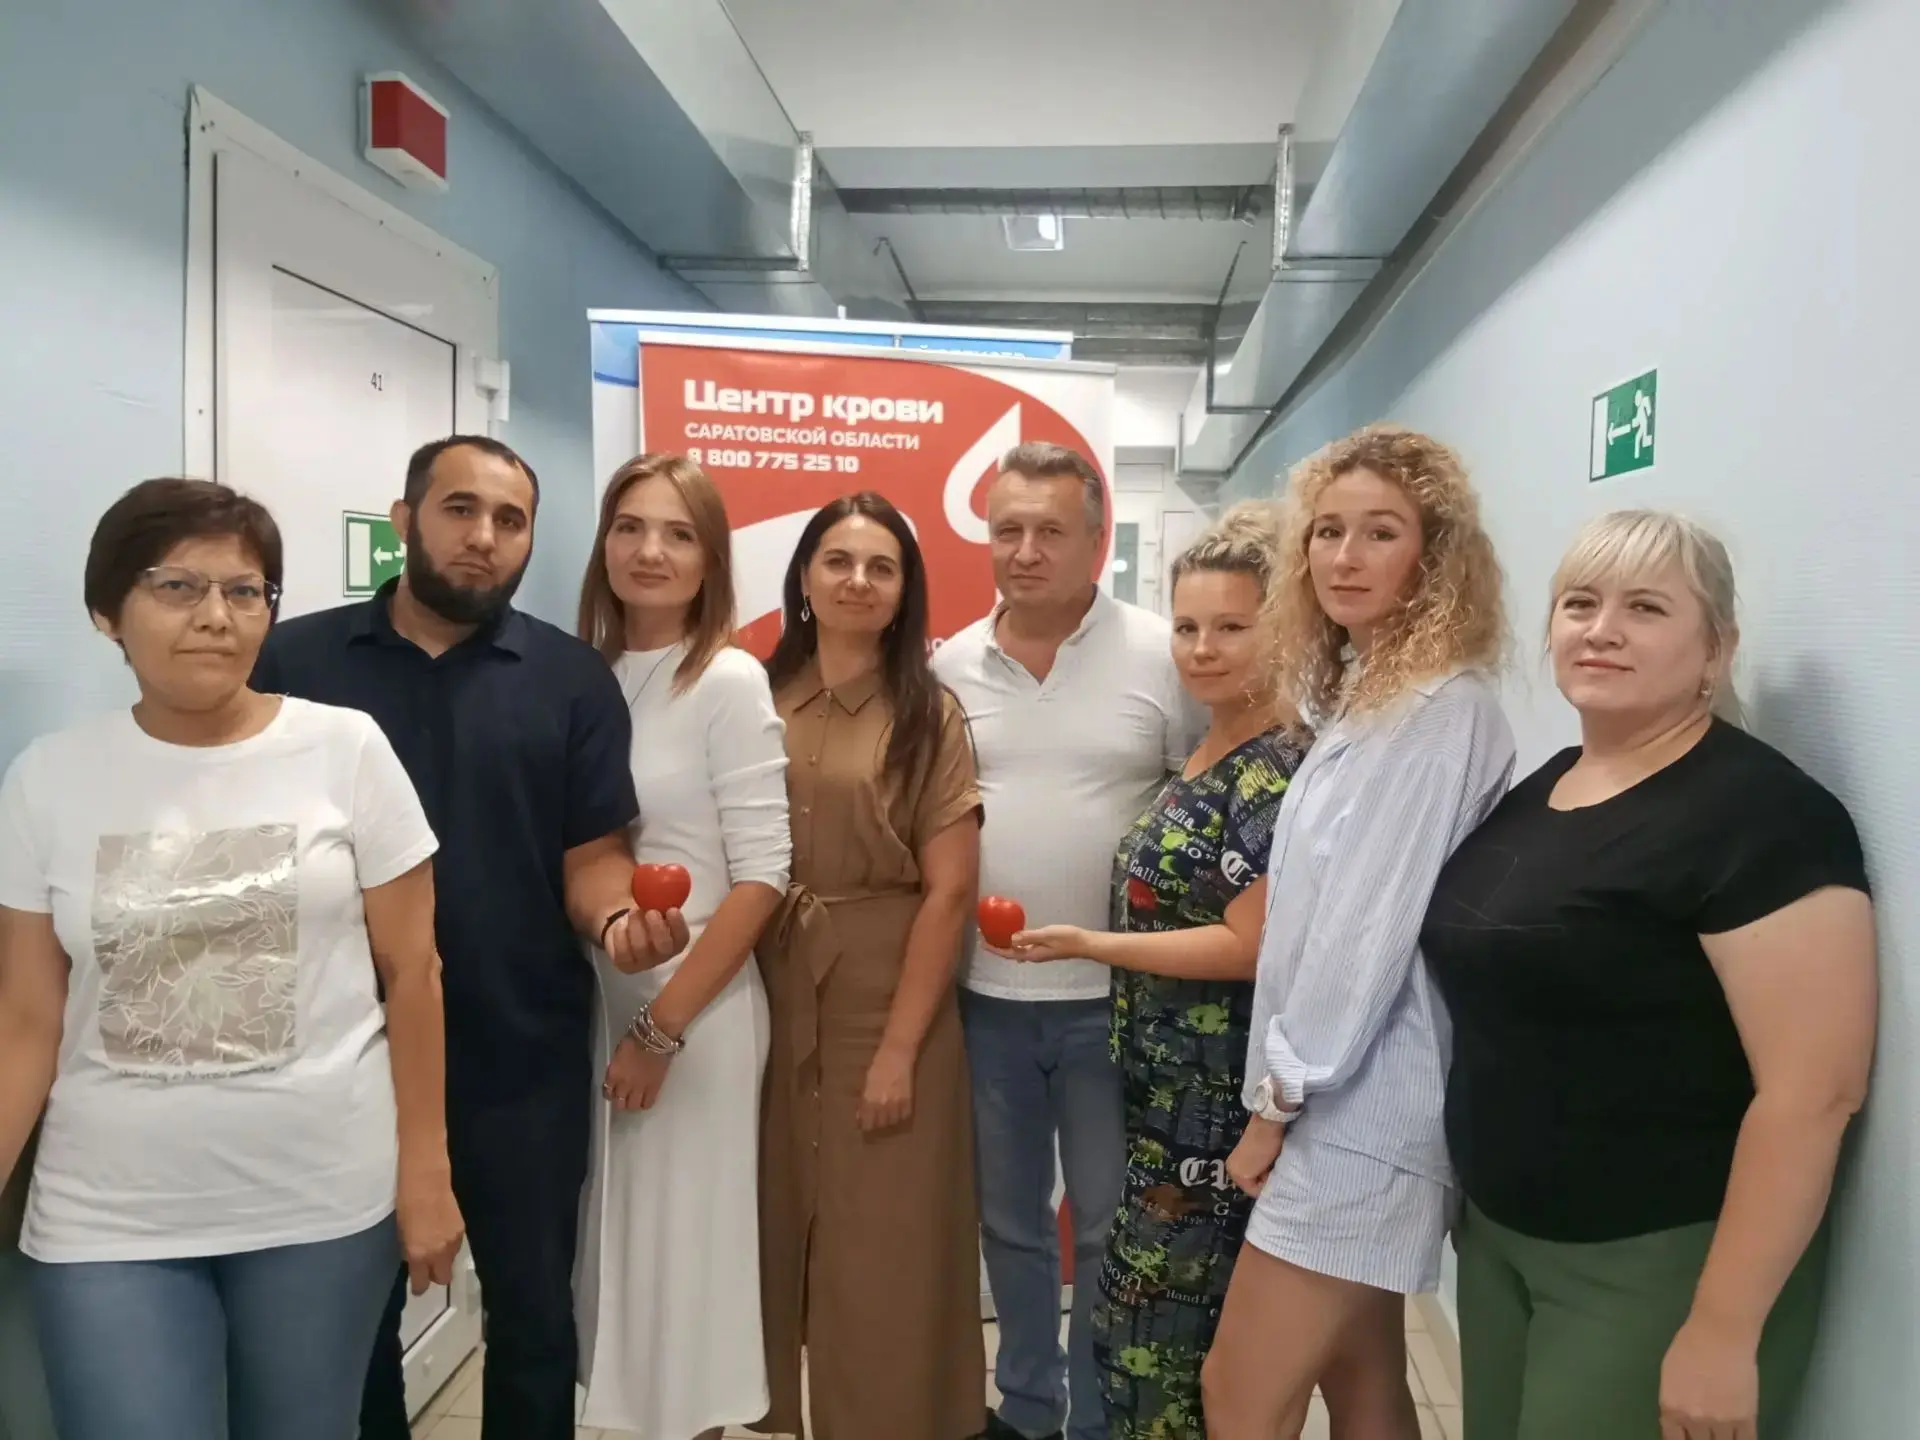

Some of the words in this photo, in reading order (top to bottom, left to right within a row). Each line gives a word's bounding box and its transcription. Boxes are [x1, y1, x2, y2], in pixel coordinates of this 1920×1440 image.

[371, 372, 382, 391] 41
[684, 379, 815, 422] Центр
[822, 395, 944, 425] крови
[684, 423, 827, 446] САРАТОВСКОЙ
[830, 432, 920, 450] ОБЛАСТИ
[707, 449, 752, 468] 800
[754, 451, 799, 470] 775
[802, 454, 832, 472] 25
[835, 455, 860, 473] 10
